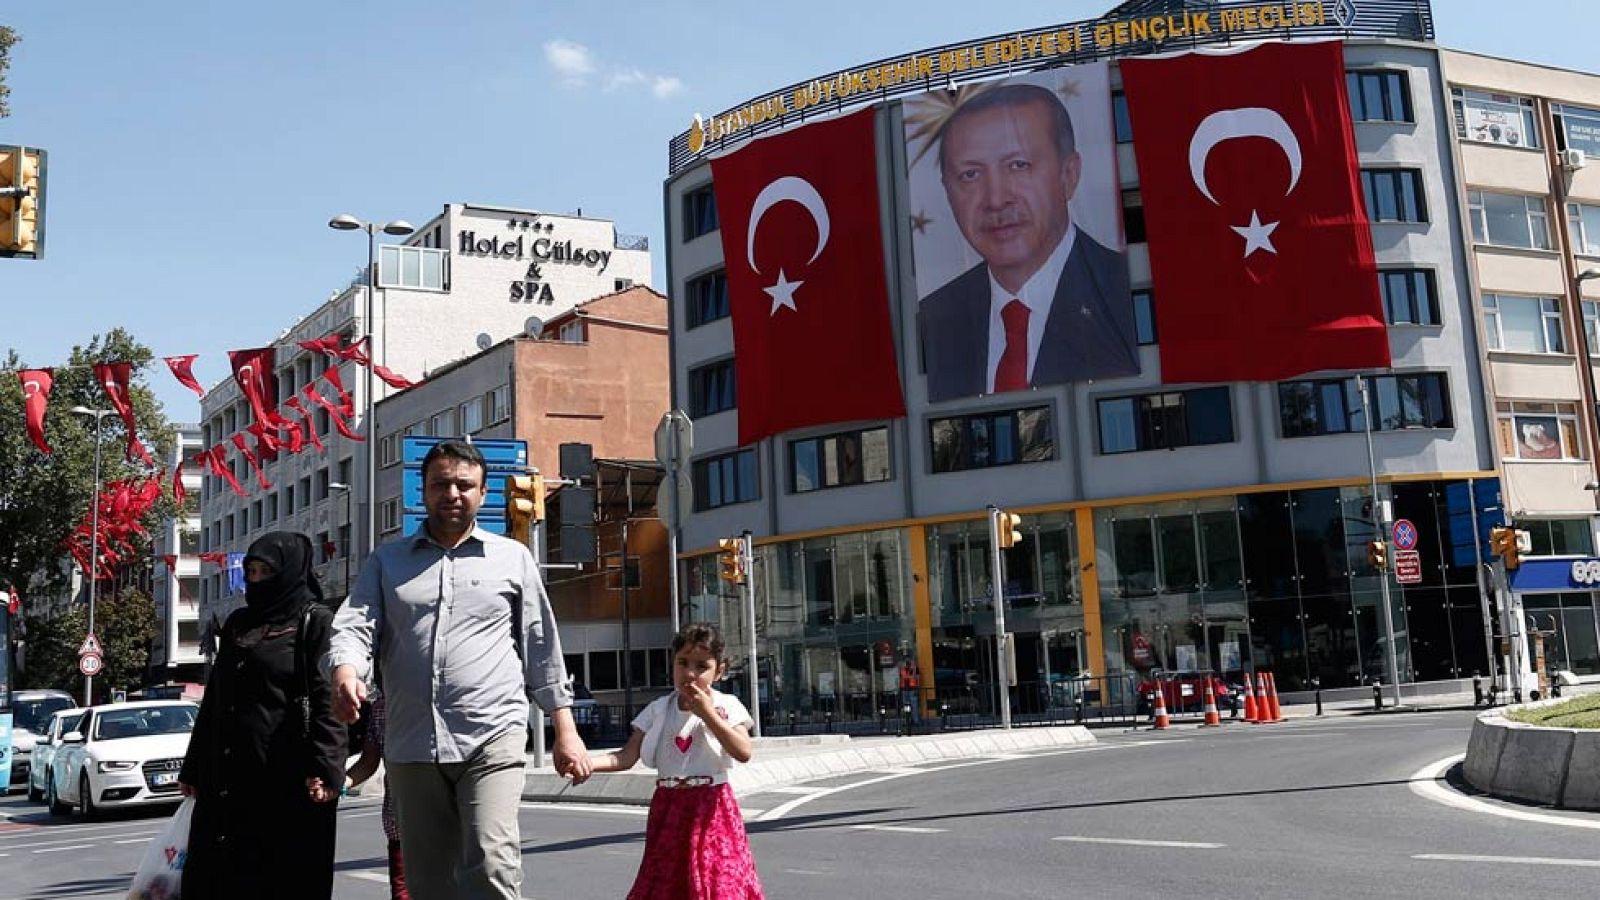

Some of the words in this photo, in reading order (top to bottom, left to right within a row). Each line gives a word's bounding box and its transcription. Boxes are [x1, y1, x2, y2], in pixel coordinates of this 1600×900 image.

[708, 96, 787, 143] İSTANBUL
[939, 25, 1081, 73] BELEDİYESİ
[1094, 9, 1211, 47] GENÇLİK
[1221, 0, 1325, 31] MECLİSİ
[459, 229, 523, 258] Hotel
[532, 237, 611, 275] Gülsoy
[526, 261, 542, 279] &
[509, 280, 555, 302] SPA
